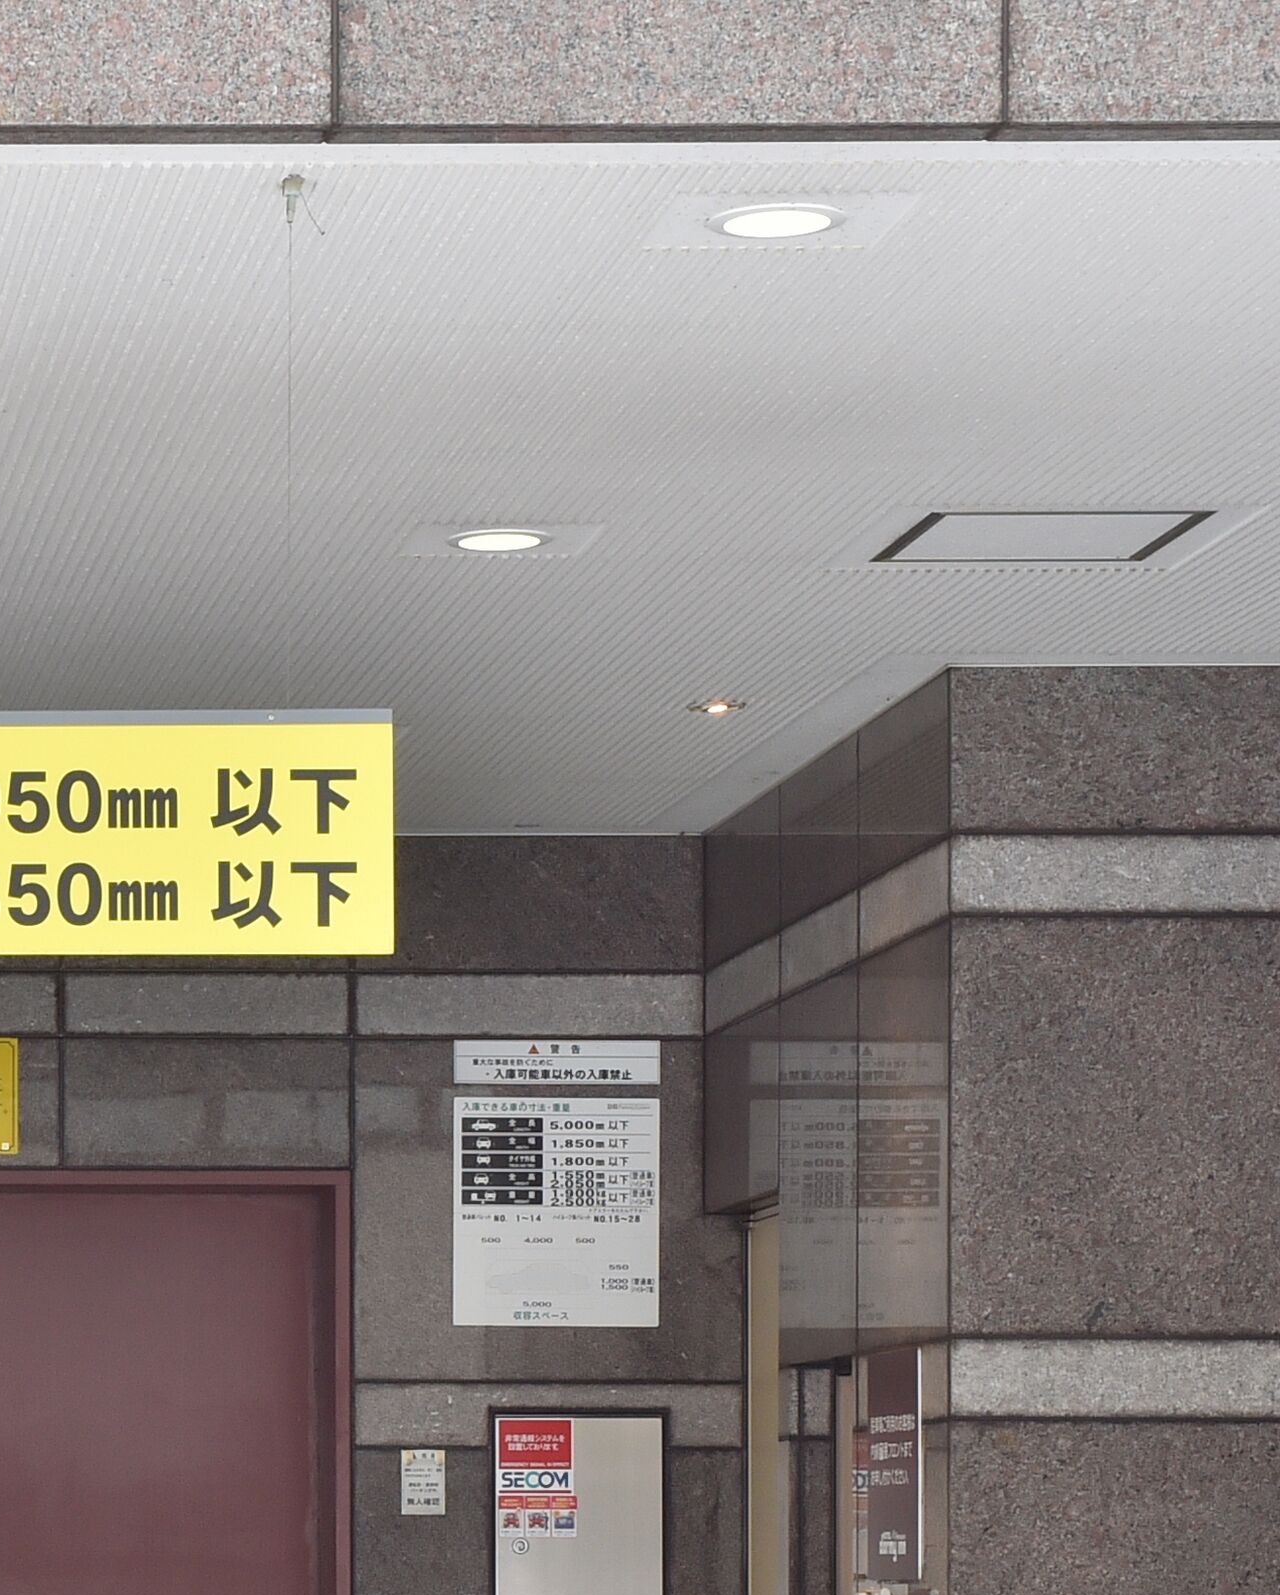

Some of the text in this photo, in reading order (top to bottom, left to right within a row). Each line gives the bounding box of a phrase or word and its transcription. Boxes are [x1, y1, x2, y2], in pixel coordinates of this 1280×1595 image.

[210, 767, 358, 836] 以下
[210, 860, 358, 928] 以下
[501, 1471, 569, 1489] SECOM
